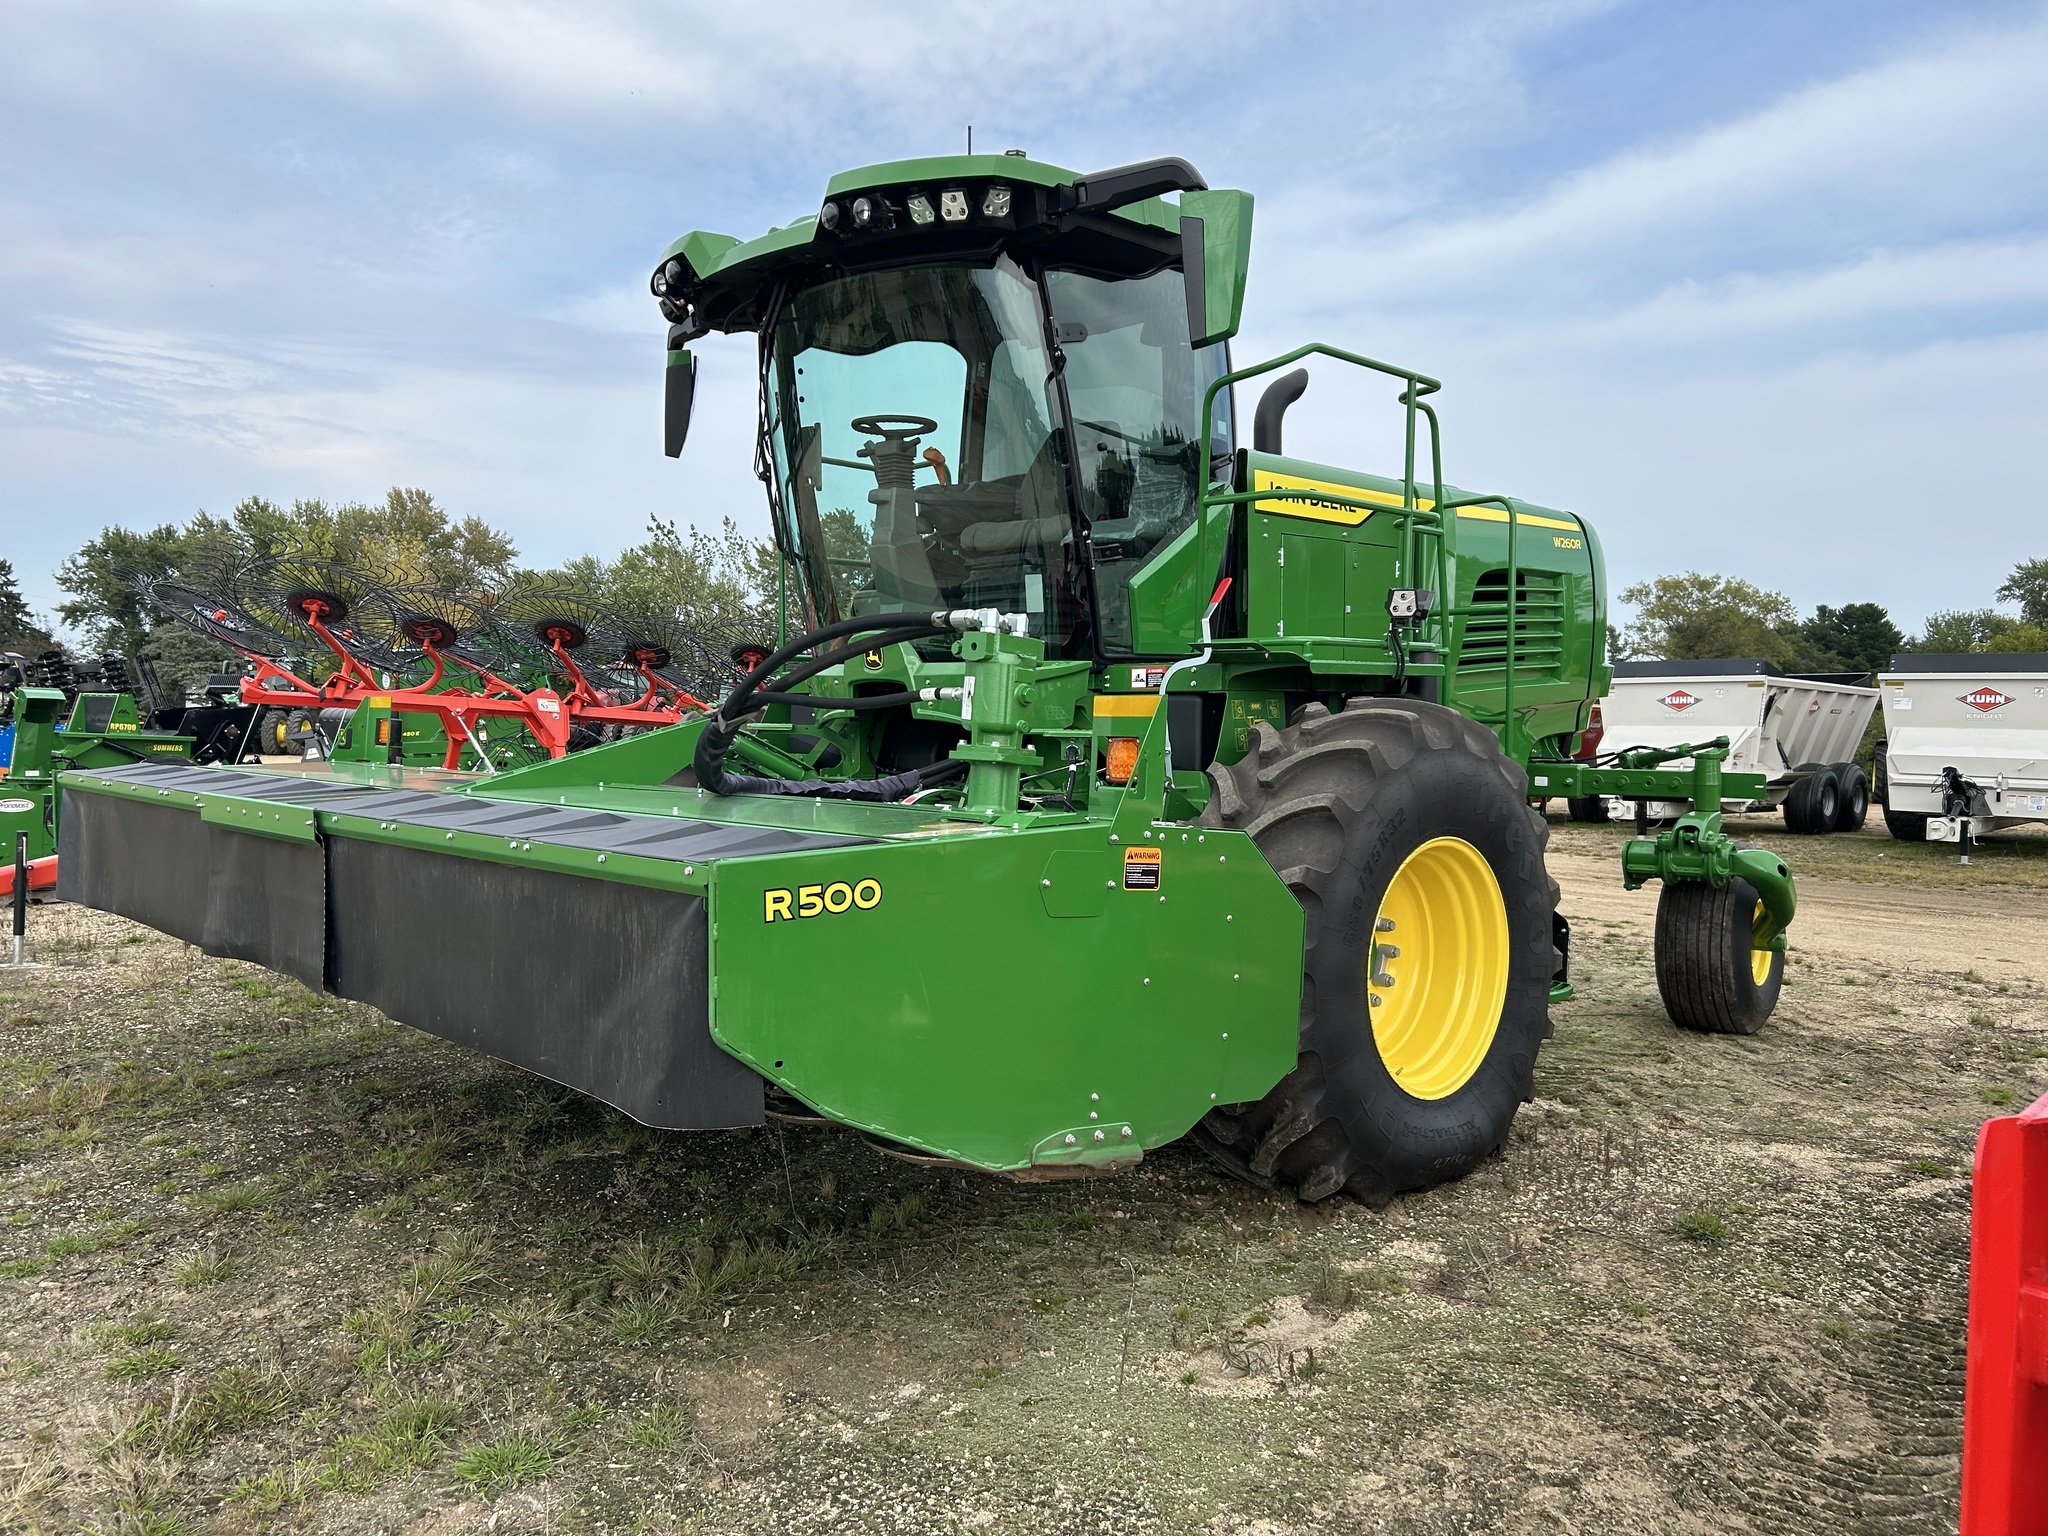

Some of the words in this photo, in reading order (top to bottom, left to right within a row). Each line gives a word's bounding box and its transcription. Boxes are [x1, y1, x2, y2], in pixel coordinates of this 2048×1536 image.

[1552, 536, 1582, 550] W260R
[1665, 696, 1695, 704] KUHN
[1966, 694, 2005, 704] KUHN
[110, 722, 137, 732] RP6700
[152, 744, 184, 752] SUMMERS
[1133, 851, 1160, 860] WARNING
